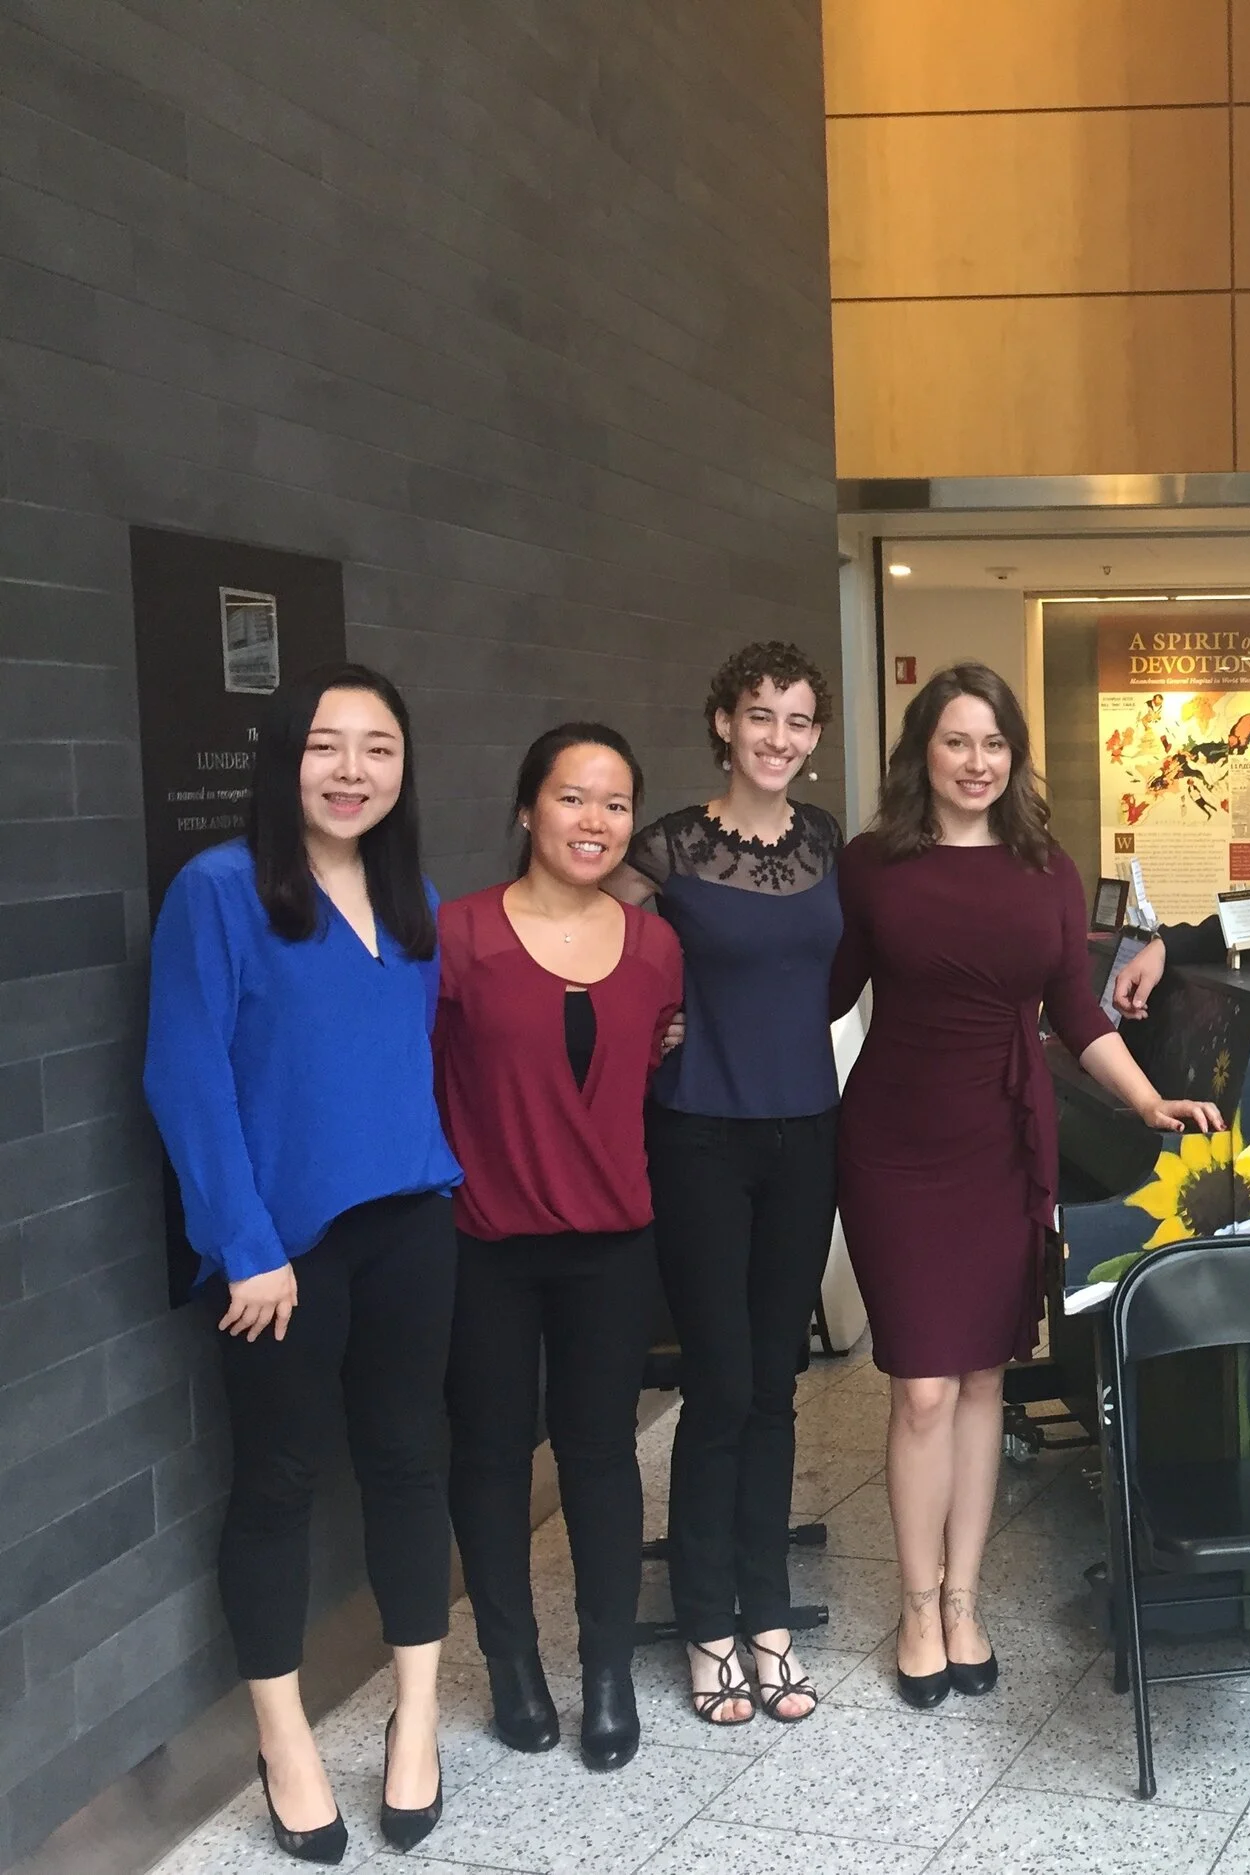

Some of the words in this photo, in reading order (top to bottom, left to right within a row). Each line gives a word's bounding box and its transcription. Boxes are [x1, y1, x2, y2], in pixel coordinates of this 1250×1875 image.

[1129, 632, 1146, 650] A
[1153, 632, 1240, 650] SPIRIT
[247, 727, 259, 741] Th
[197, 752, 250, 770] LUNDER
[178, 817, 207, 831] PETER
